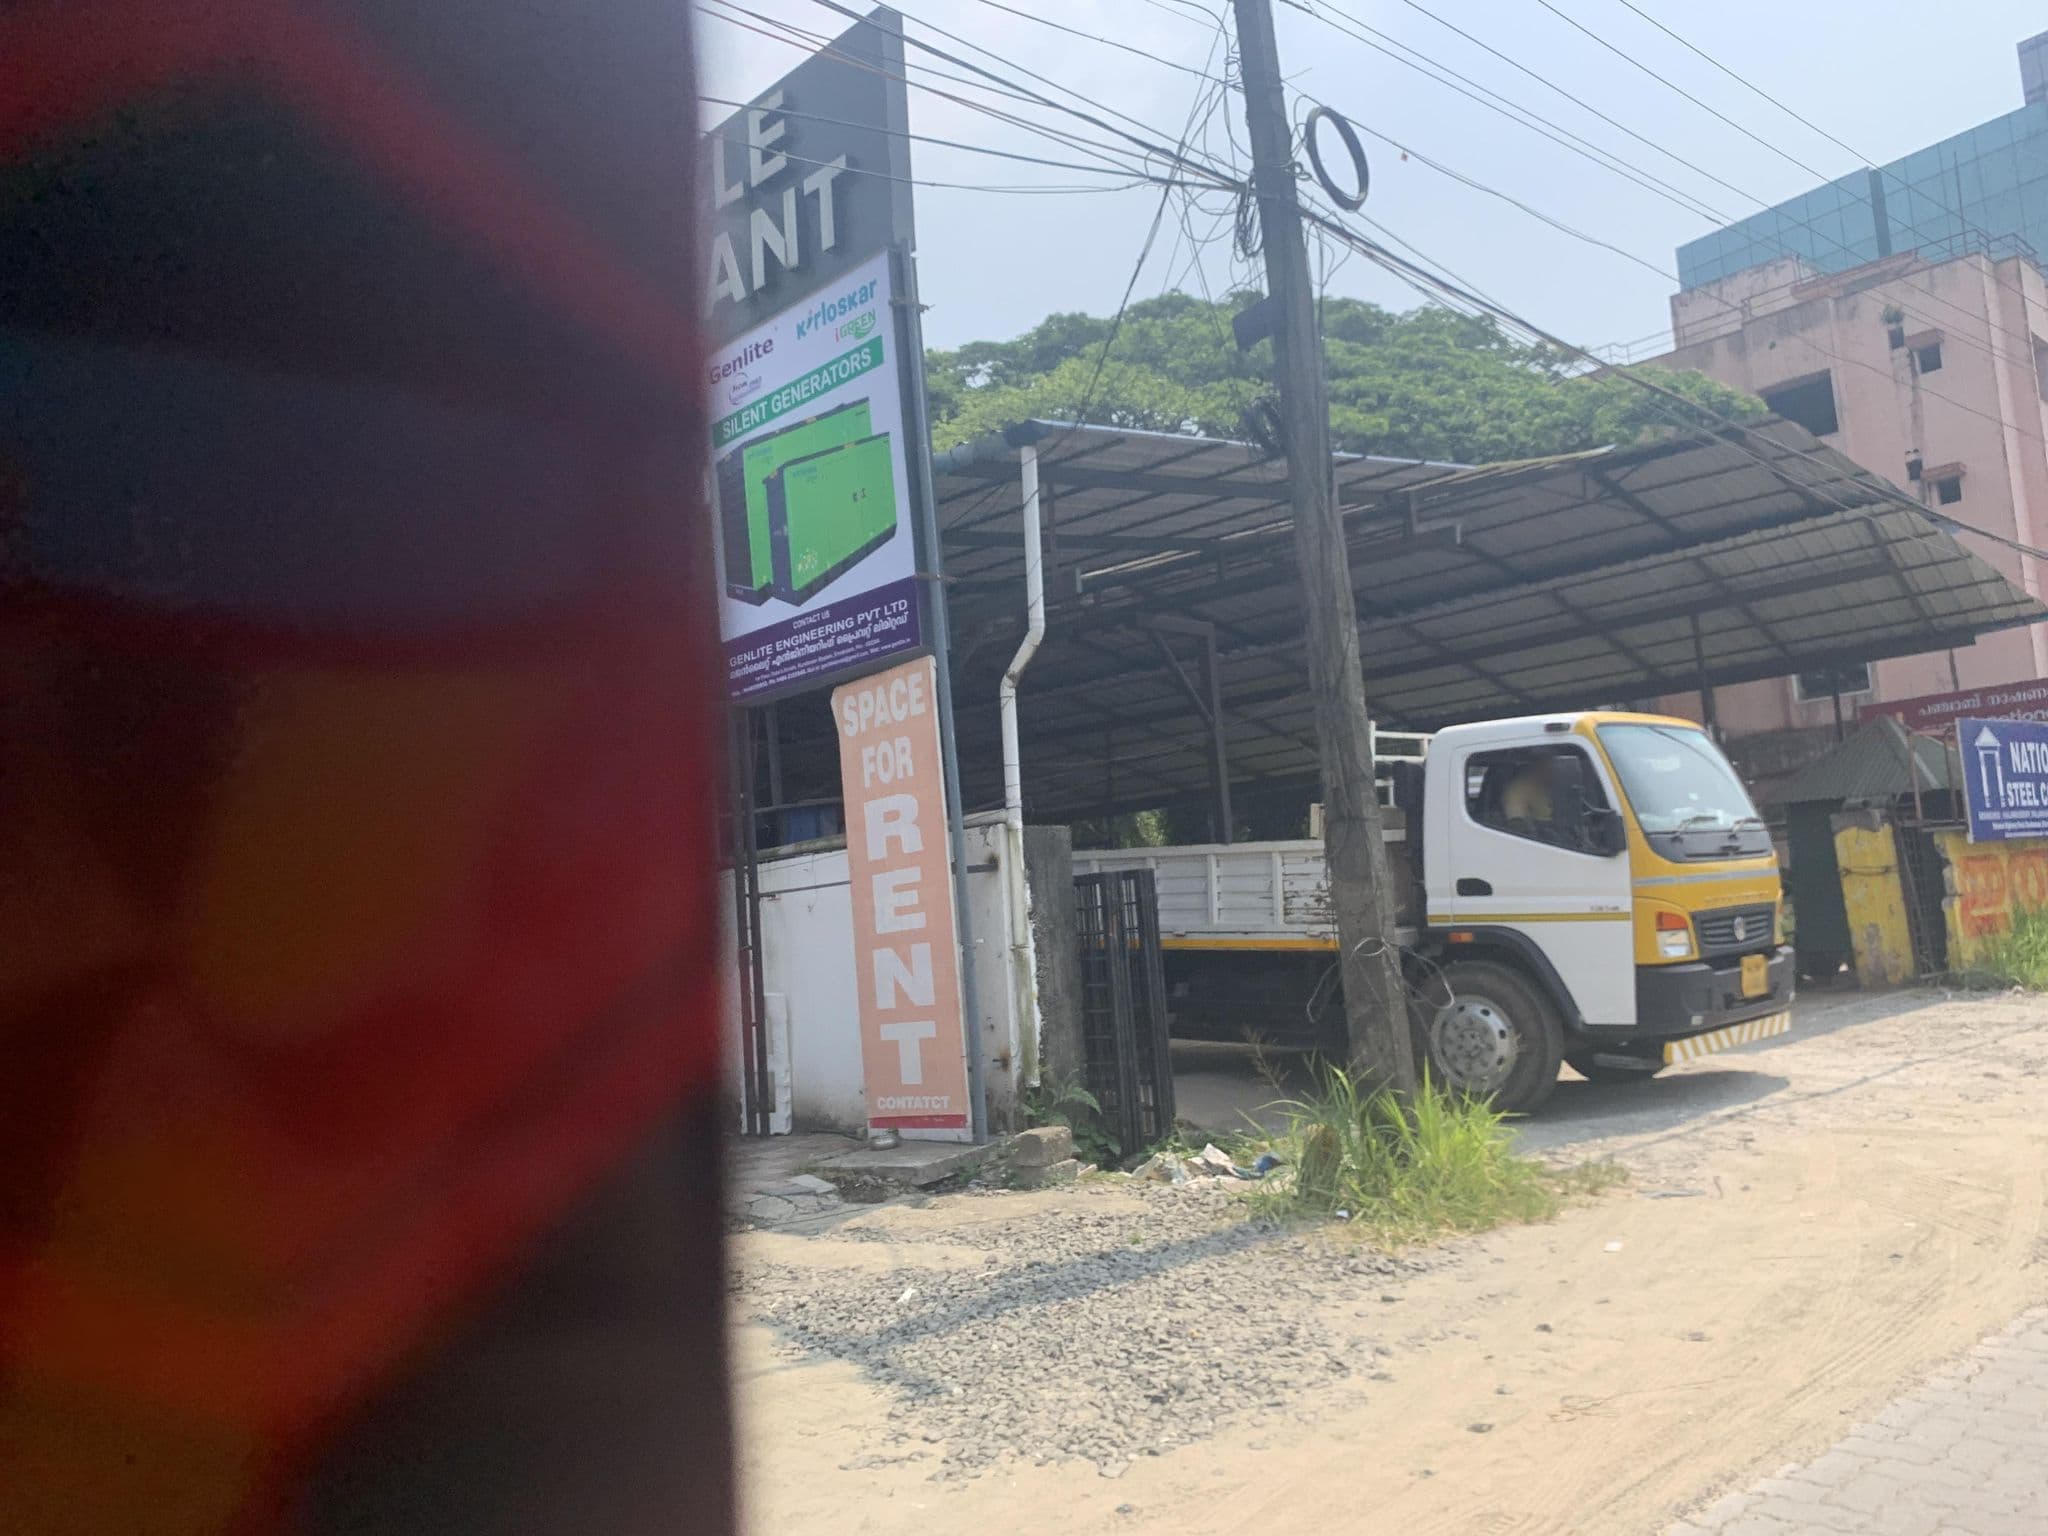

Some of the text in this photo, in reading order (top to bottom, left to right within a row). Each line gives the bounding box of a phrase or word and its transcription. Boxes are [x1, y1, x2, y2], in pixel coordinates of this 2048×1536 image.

[796, 277, 877, 340] kirloskar
[710, 337, 774, 384] Genlite
[722, 347, 872, 440] SILENT GENERATORS
[729, 644, 773, 667] GENLITE
[776, 617, 854, 652] ENGINEERING
[857, 607, 880, 625] PVT
[884, 599, 908, 616] LTD
[792, 609, 830, 629] CONTACT US
[842, 671, 926, 738] SPACE
[862, 735, 914, 788] FOR
[2006, 781, 2040, 808] STEEL
[864, 793, 936, 1086] RENT
